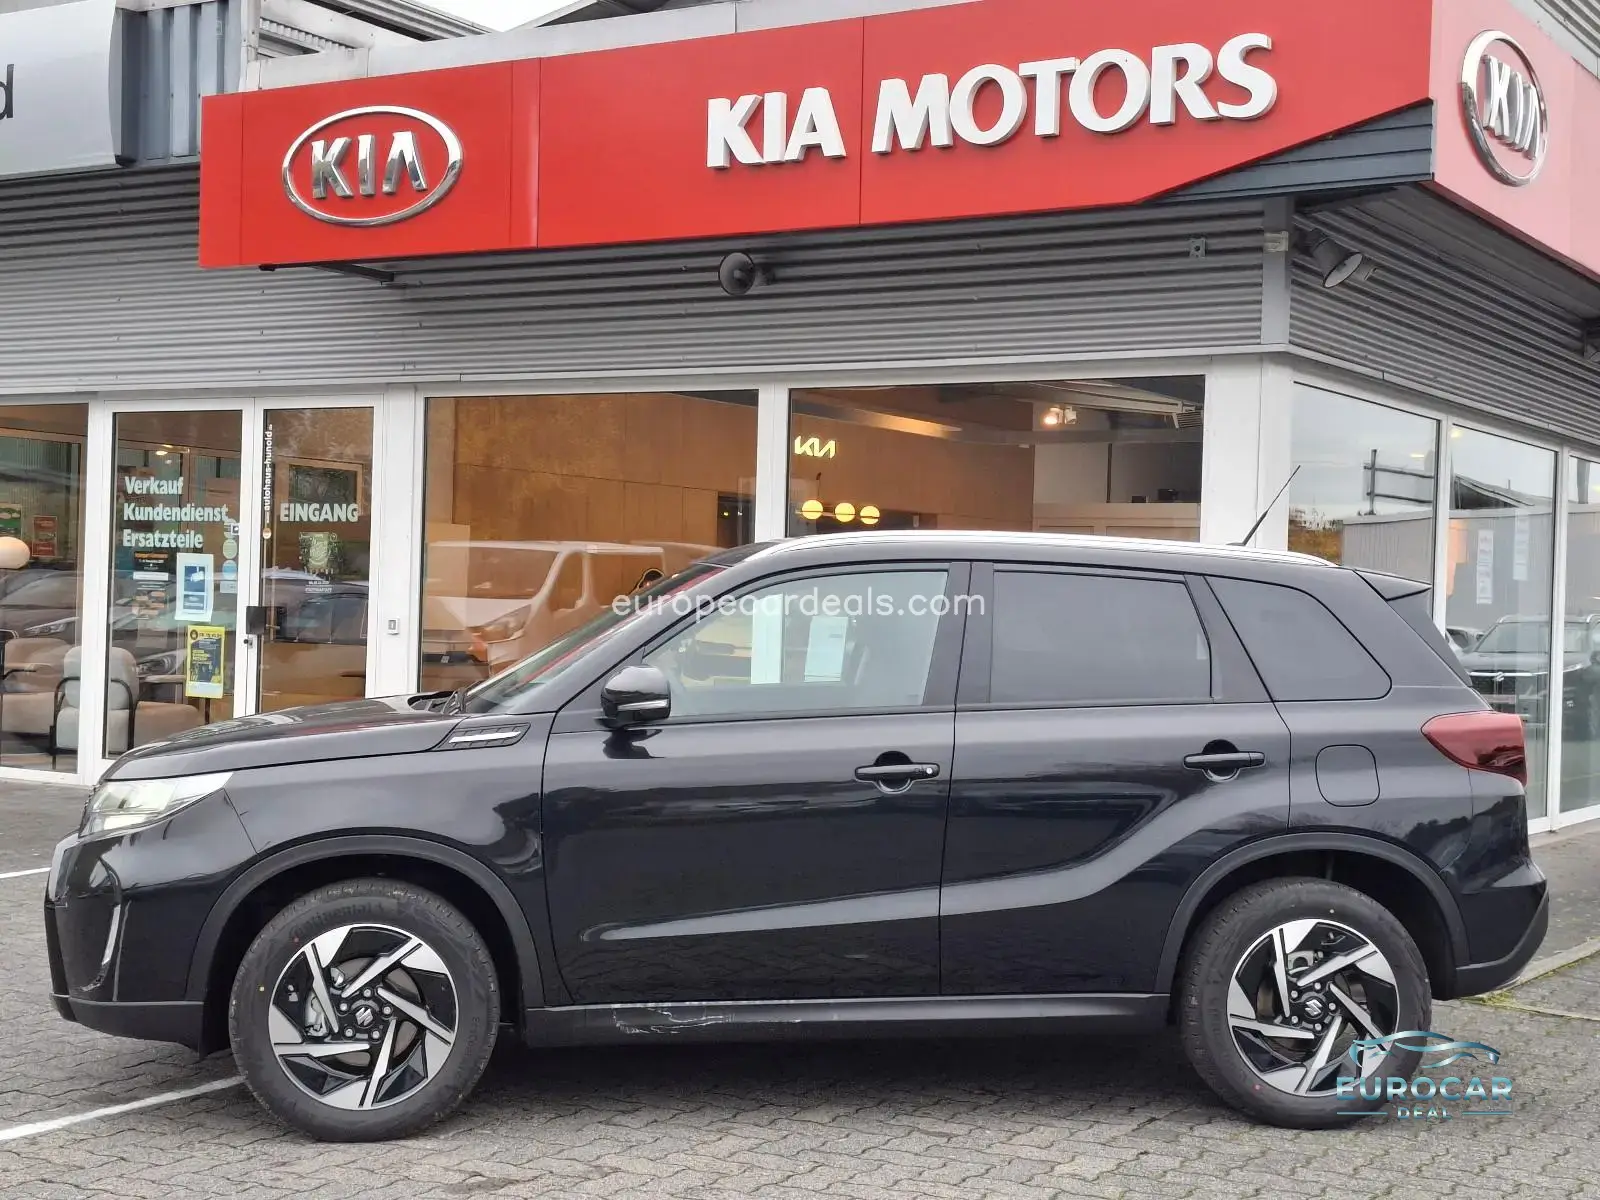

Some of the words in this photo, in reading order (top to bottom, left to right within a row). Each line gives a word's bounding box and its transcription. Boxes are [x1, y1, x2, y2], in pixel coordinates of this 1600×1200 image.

[706, 87, 846, 170] KIA
[871, 33, 1278, 154] MOTORS
[1482, 54, 1538, 160] KIA
[311, 131, 429, 199] KIA
[124, 476, 184, 495] Verkauf
[123, 502, 229, 522] Kundendienst
[280, 503, 359, 522] EINGANG
[122, 528, 204, 549] Ersatzteile
